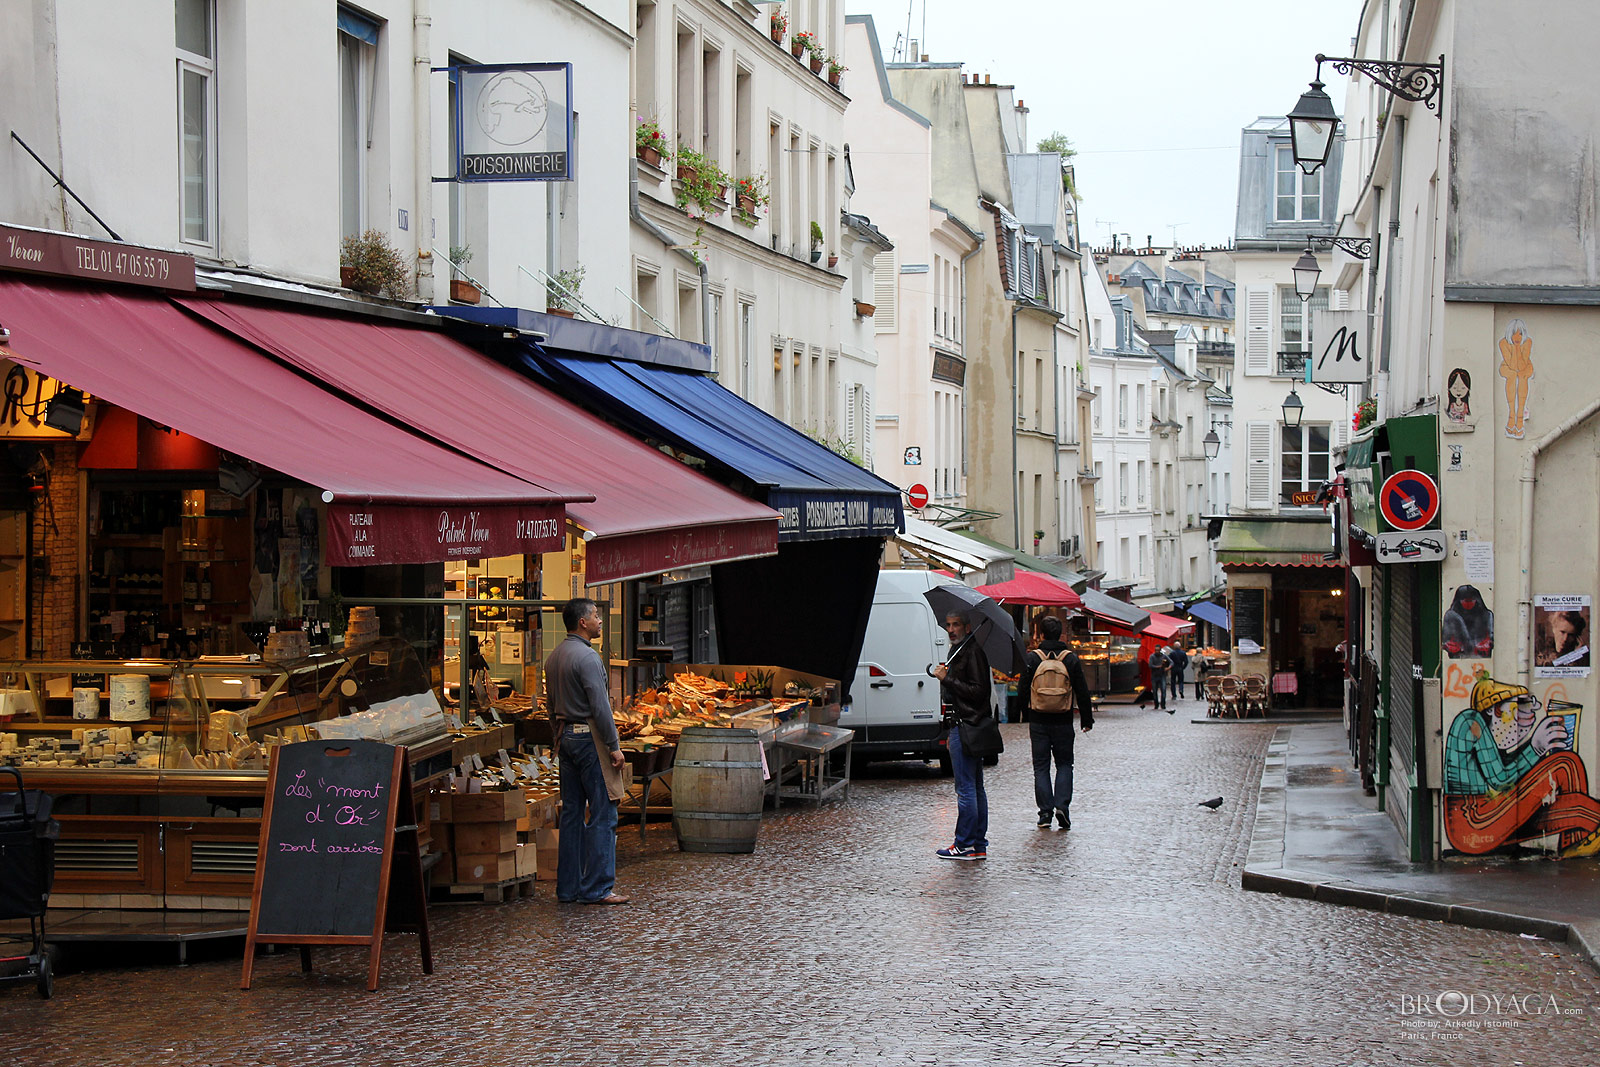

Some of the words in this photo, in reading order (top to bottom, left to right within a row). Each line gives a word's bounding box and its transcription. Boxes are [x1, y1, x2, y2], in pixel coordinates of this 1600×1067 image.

[464, 153, 563, 175] POISSONNERIE
[6, 234, 45, 264] Veron
[75, 246, 99, 271] TEL
[100, 250, 113, 273] 01
[115, 252, 128, 275] 47
[129, 254, 142, 277] 05
[144, 256, 156, 279] 55
[157, 258, 170, 281] 79
[349, 513, 374, 526] PLATEAUX
[437, 510, 467, 544] Patrick
[468, 511, 490, 543] Veron
[354, 530, 359, 542] A
[359, 530, 368, 542] LA
[348, 545, 376, 558] COMMANDE
[285, 769, 313, 799] Les
[279, 838, 319, 854] sont
[327, 840, 384, 854] arrivés
